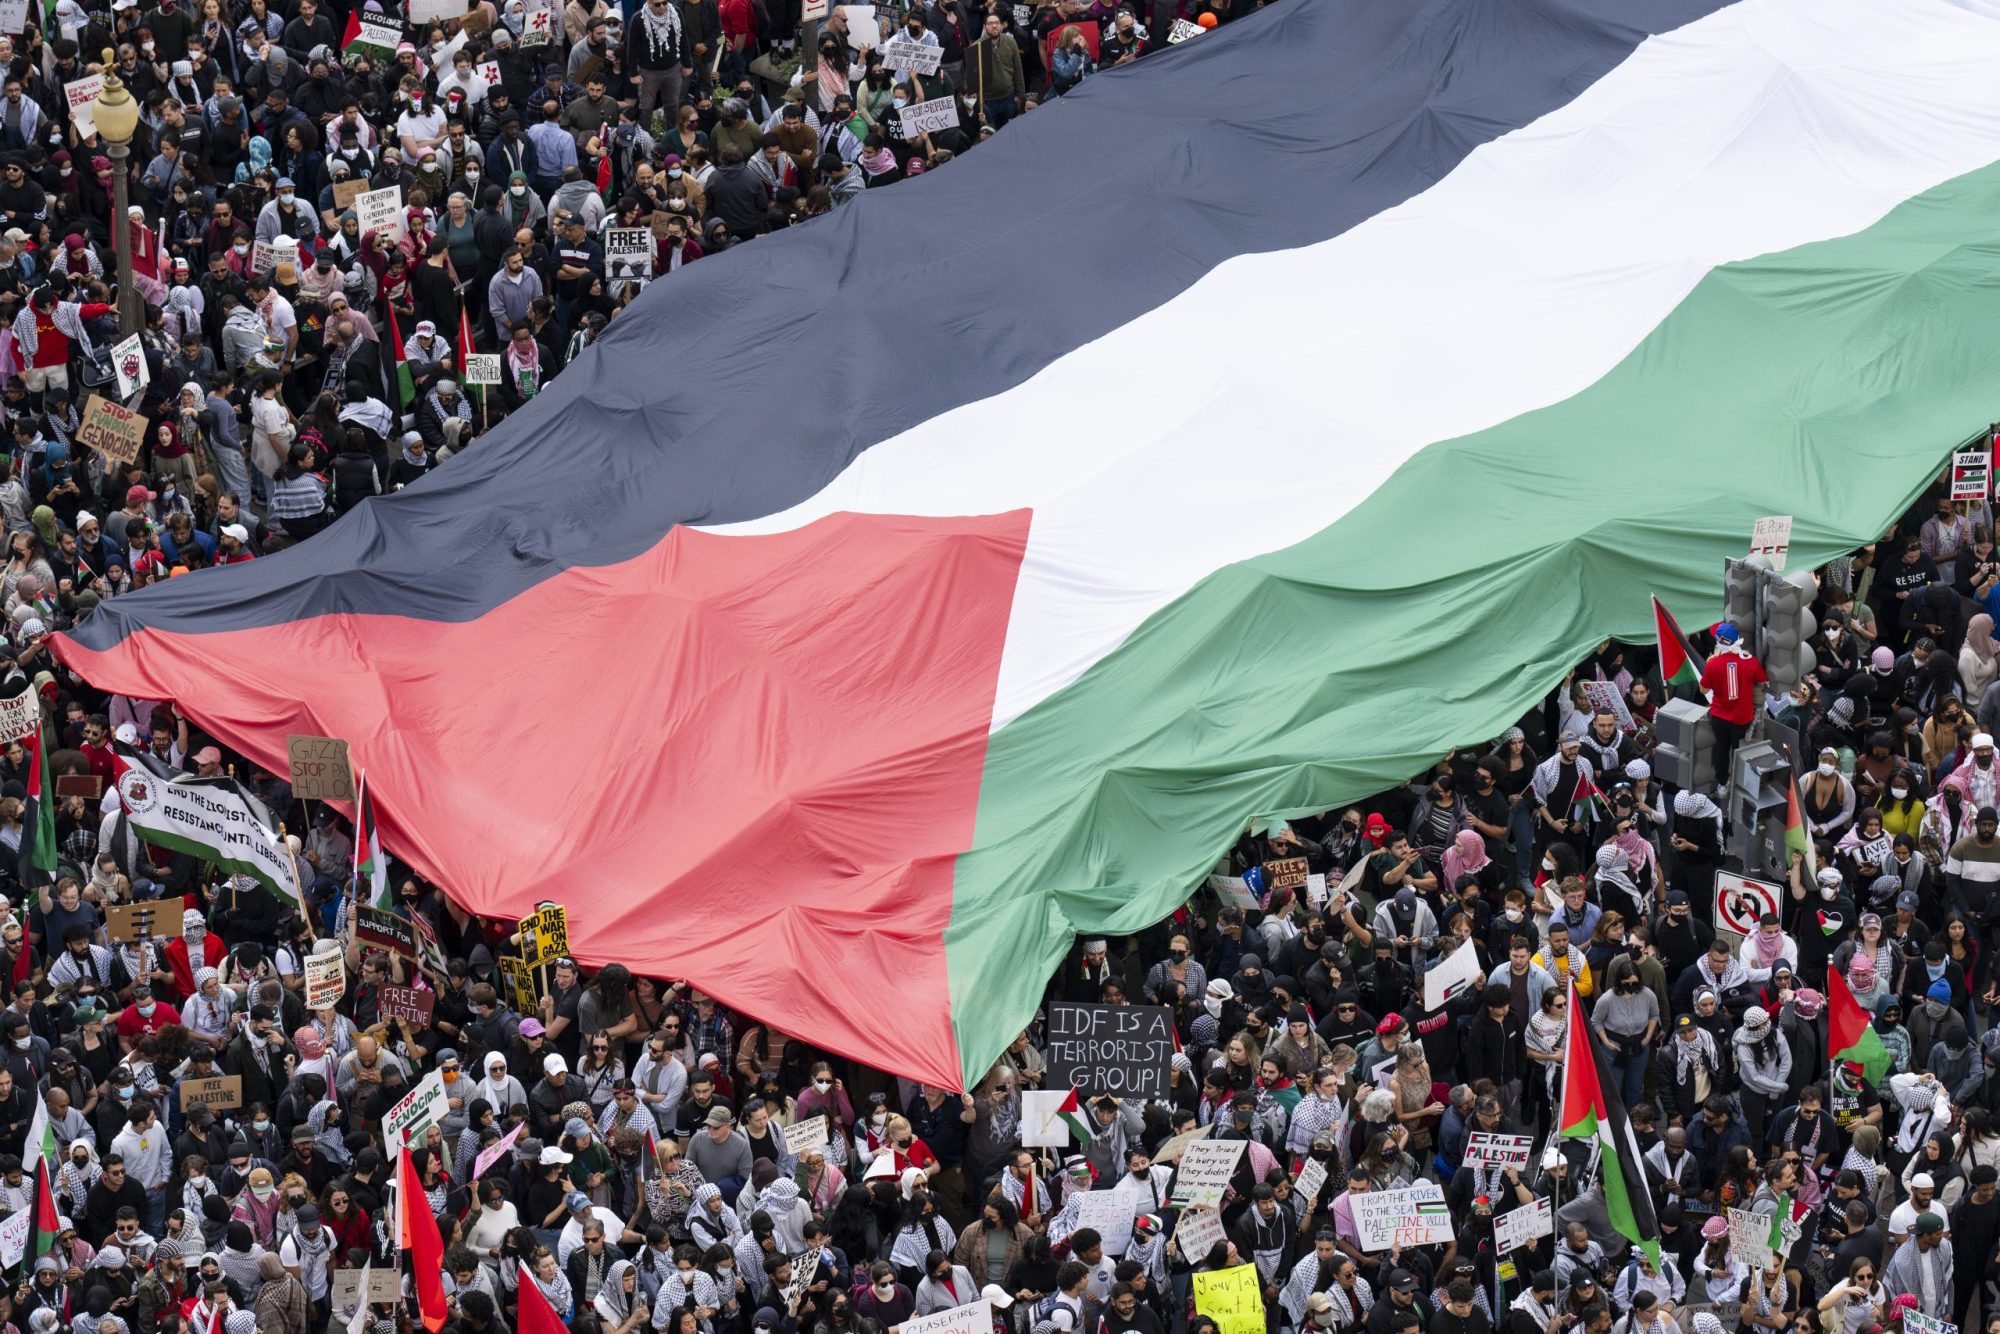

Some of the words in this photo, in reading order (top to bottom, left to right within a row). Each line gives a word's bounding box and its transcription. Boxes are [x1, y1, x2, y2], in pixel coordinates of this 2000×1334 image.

[363, 25, 399, 45] PALESTINE
[70, 91, 102, 107] GENOCID
[914, 113, 950, 135] NOW
[361, 190, 395, 206] GENERATION
[363, 207, 396, 221] GENERATION
[609, 231, 647, 247] FREE
[607, 245, 650, 255] PALESTINE
[115, 341, 140, 361] PALESTINE
[476, 357, 493, 368] END
[101, 401, 133, 421] STOP
[90, 408, 137, 440] FUNDING
[82, 423, 138, 461] GENOCIDE
[1959, 455, 1984, 464] STAND
[1955, 483, 1984, 491] PALESTINE
[1895, 572, 1926, 586] RESIST
[291, 740, 348, 761] GAZA
[292, 761, 327, 777] STOP
[332, 763, 350, 778] PA
[295, 779, 354, 800] HOLOC
[190, 790, 205, 809] THE
[1866, 840, 1887, 857] AVE
[256, 844, 296, 885] LIBERATION
[1268, 861, 1297, 875] FREE
[1272, 873, 1308, 888] ALESTINE
[520, 917, 540, 935] END
[542, 908, 565, 924] THE
[540, 920, 565, 936] WAR
[358, 919, 394, 935] SUPPORT
[396, 931, 411, 945] FOR
[552, 931, 567, 944] ON
[542, 941, 568, 957] GAZA
[307, 953, 342, 969] CONGRESS
[310, 991, 344, 1007] GENOCIDE
[320, 989, 335, 998] NOT
[384, 987, 419, 1006] FREE
[383, 1004, 430, 1026] ALESTINE
[1051, 1008, 1109, 1036] IDF
[1115, 1012, 1143, 1033] IS
[1149, 1014, 1167, 1037] A
[1050, 1040, 1170, 1063] TERRORIST
[203, 1081, 222, 1090] FREE
[1070, 1066, 1161, 1097] GROUP!
[188, 1090, 235, 1105] PALESTINE
[390, 1090, 416, 1120] STOP
[387, 1083, 441, 1136] GENOCIDE
[1490, 1135, 1511, 1146] FREE
[1190, 1145, 1211, 1157] They
[1466, 1146, 1528, 1163] PALESTINE
[1197, 1156, 1217, 1166] bury
[1180, 1166, 1202, 1178] They
[1175, 1190, 1198, 1198] eeds
[1361, 1194, 1387, 1207] FROM
[1388, 1191, 1407, 1204] THE
[1410, 1189, 1440, 1202] RIVER
[1361, 1208, 1374, 1218] TO
[1375, 1207, 1391, 1216] THE
[1394, 1205, 1414, 1215] SEA
[1729, 1210, 1747, 1222] YOU
[1828, 1202, 1848, 1219] PALEST
[1365, 1216, 1423, 1233] PALESTINE
[1425, 1215, 1448, 1227] WILL
[1503, 1217, 1530, 1237] FIRE
[12, 1236, 25, 1251] SE
[1372, 1231, 1391, 1243] BE
[793, 1248, 820, 1271] JEWS
[1198, 1276, 1232, 1296] Your
[1231, 1268, 1258, 1292] Tax
[906, 1307, 978, 1334] CEASEFIRE
[1904, 1308, 1921, 1324] END
[1922, 1316, 1939, 1332] THE
